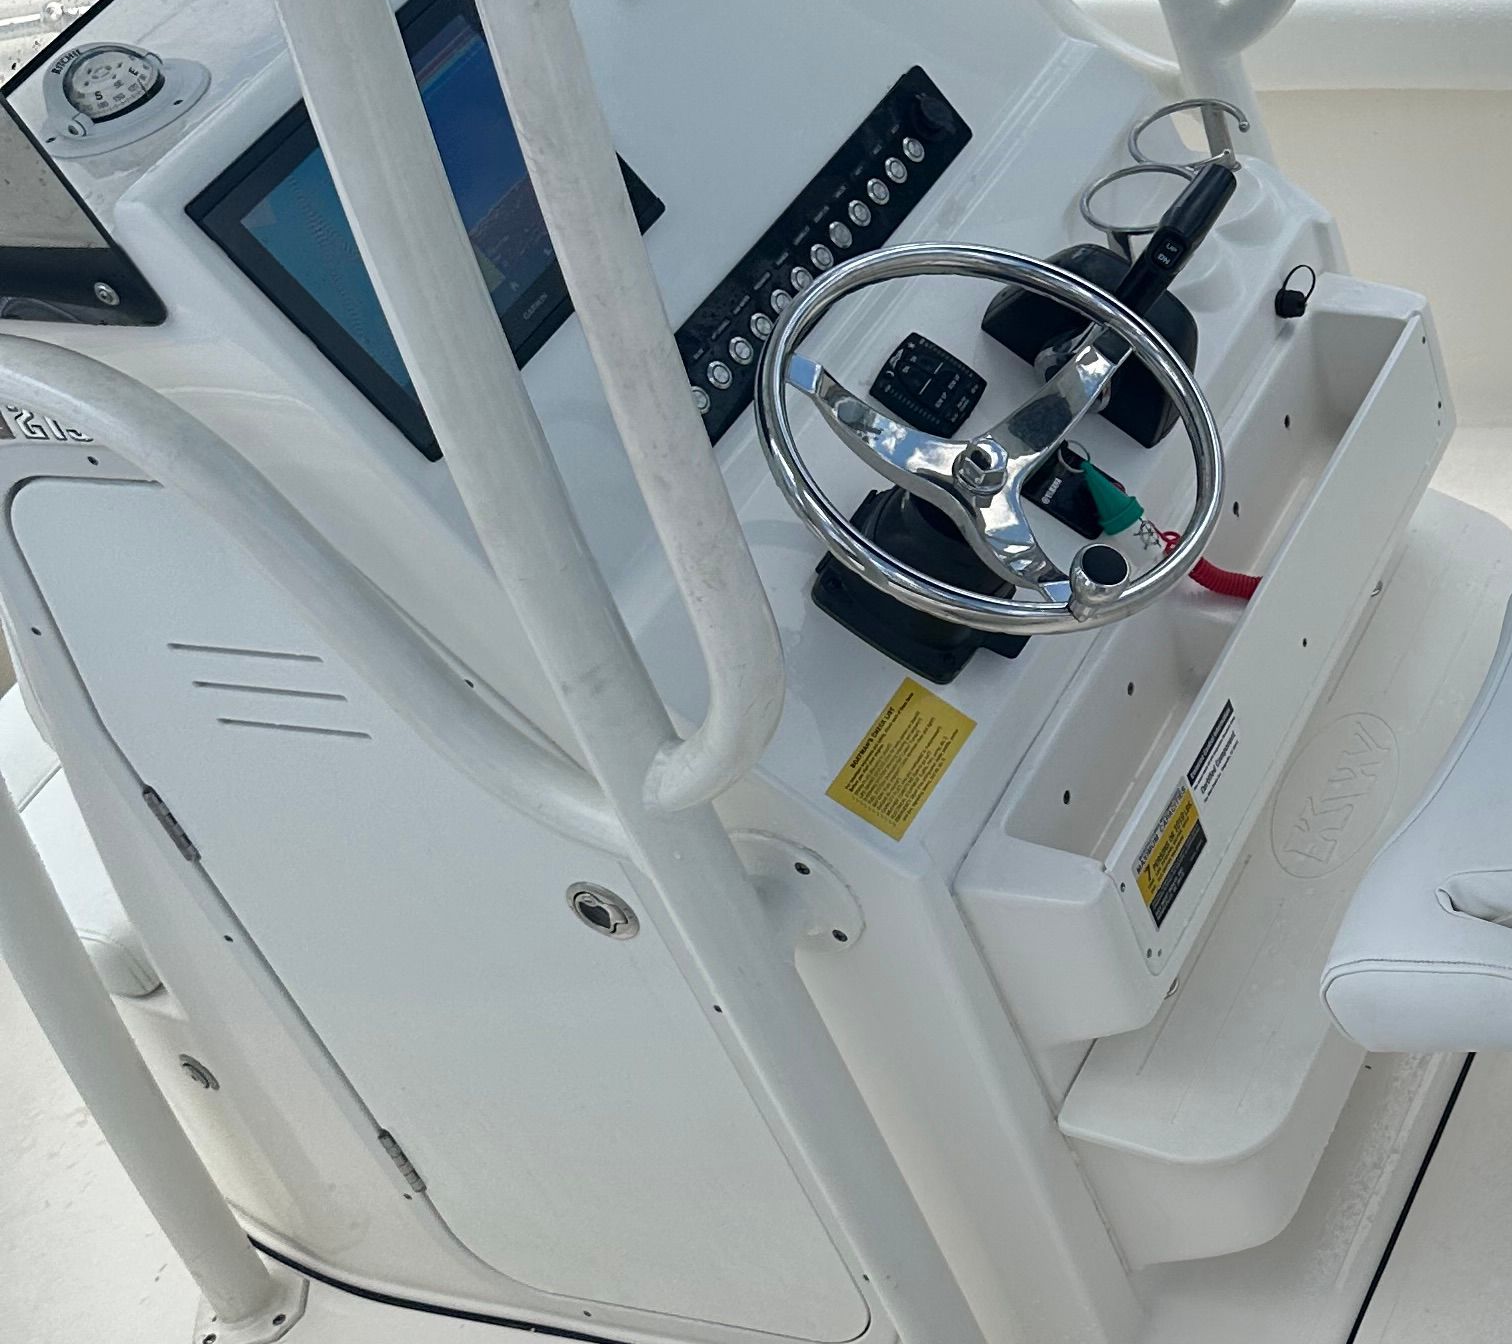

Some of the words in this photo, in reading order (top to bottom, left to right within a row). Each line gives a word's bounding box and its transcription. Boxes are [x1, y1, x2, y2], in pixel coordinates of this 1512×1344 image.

[95, 91, 103, 101] S
[1166, 243, 1178, 252] UP
[1157, 253, 1170, 264] DN
[871, 720, 887, 738] CHECK
[885, 706, 895, 719] LIST
[1144, 862, 1153, 881] 7
